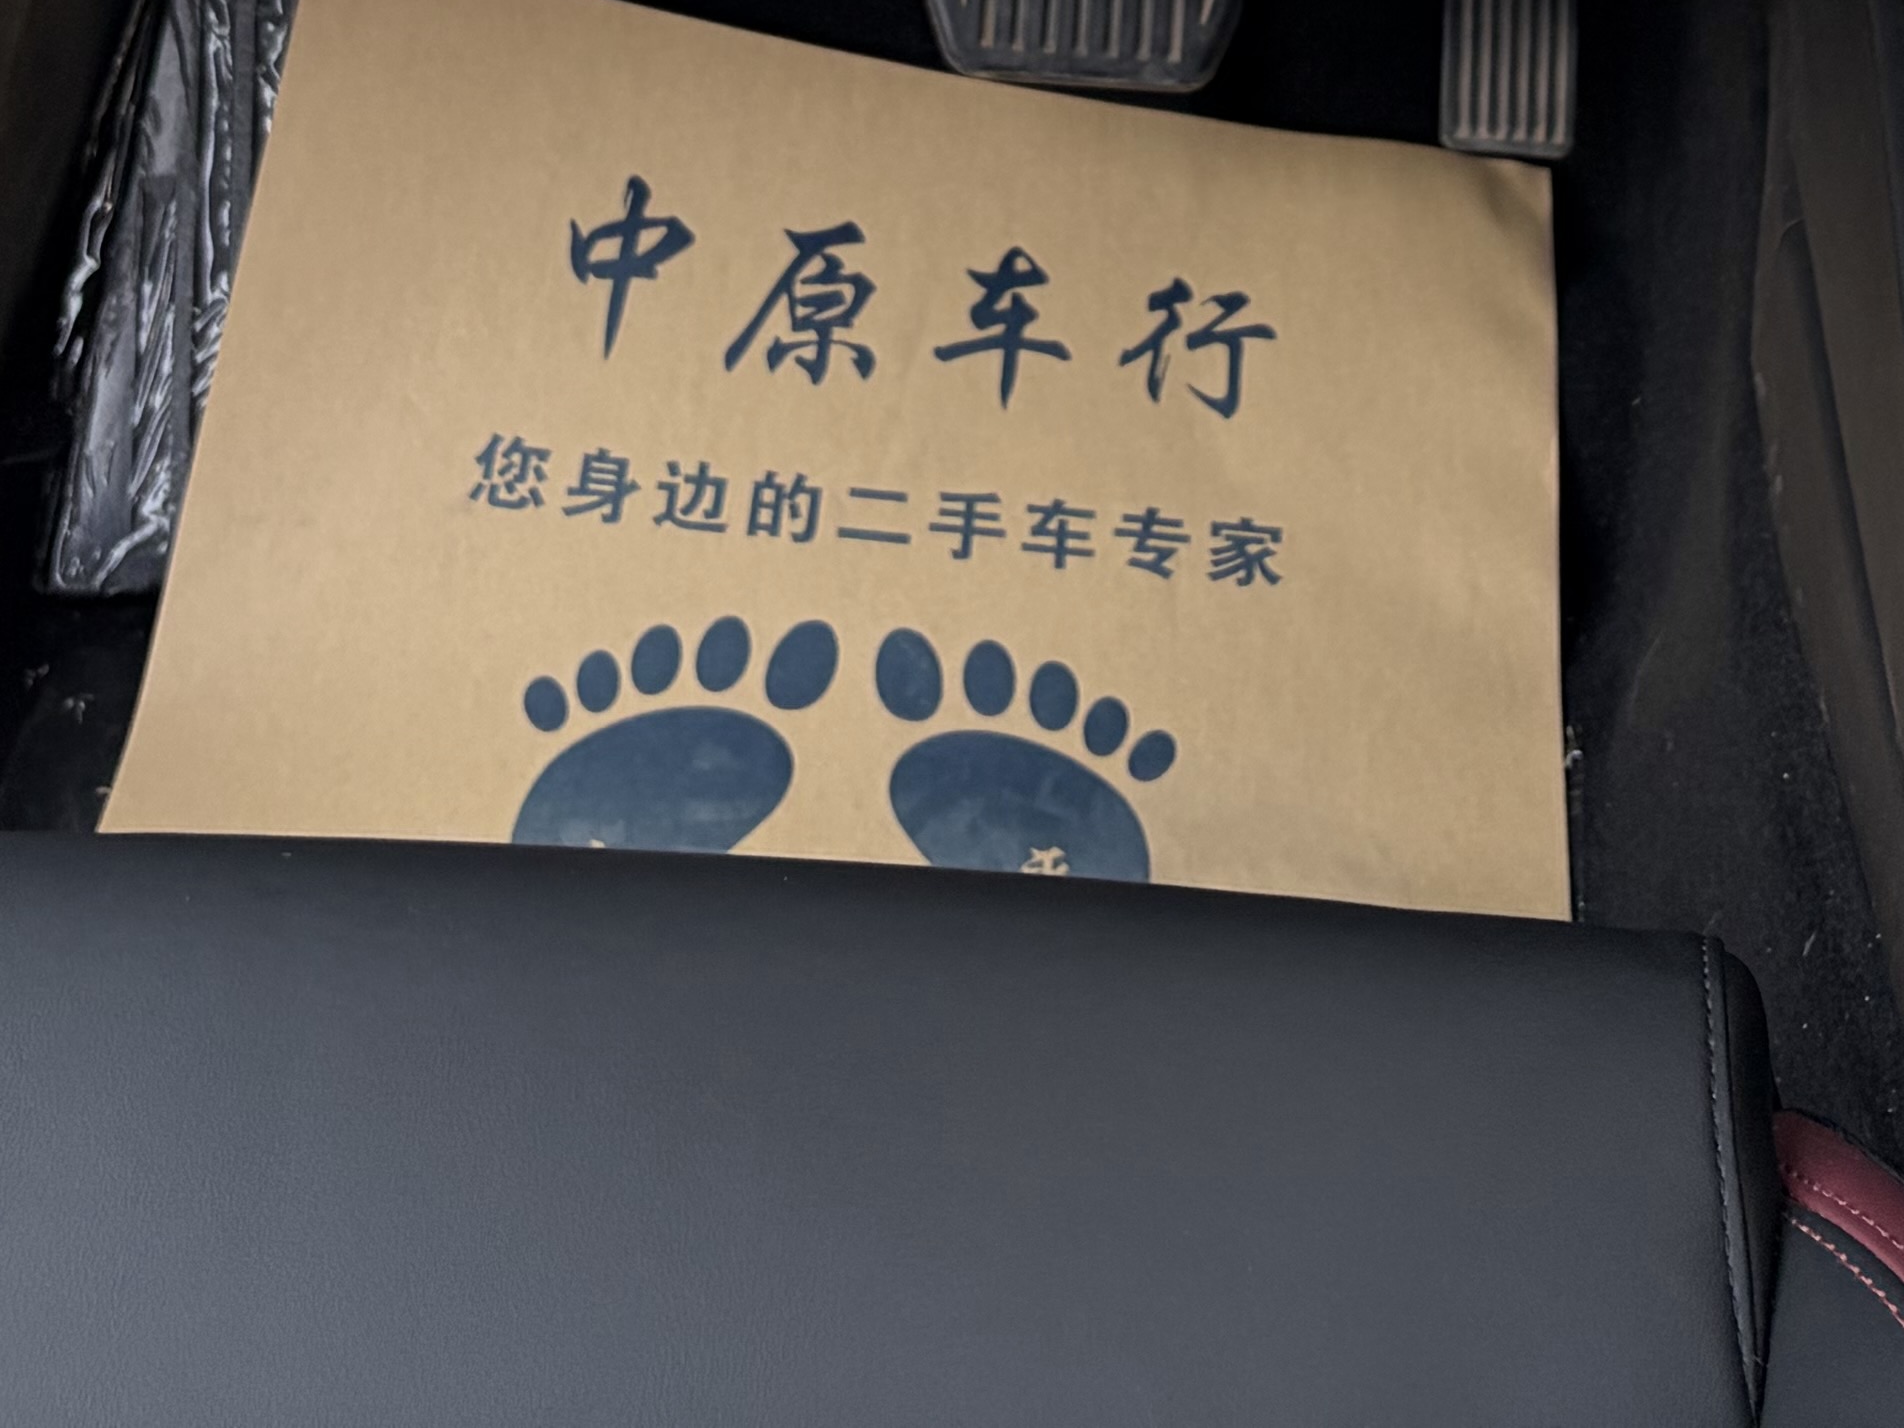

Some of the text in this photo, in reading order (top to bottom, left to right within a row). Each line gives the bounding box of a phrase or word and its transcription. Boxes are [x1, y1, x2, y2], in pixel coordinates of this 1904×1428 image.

[569, 175, 1279, 419] 中原车行
[468, 432, 1287, 587] 您身边的二手车专家
